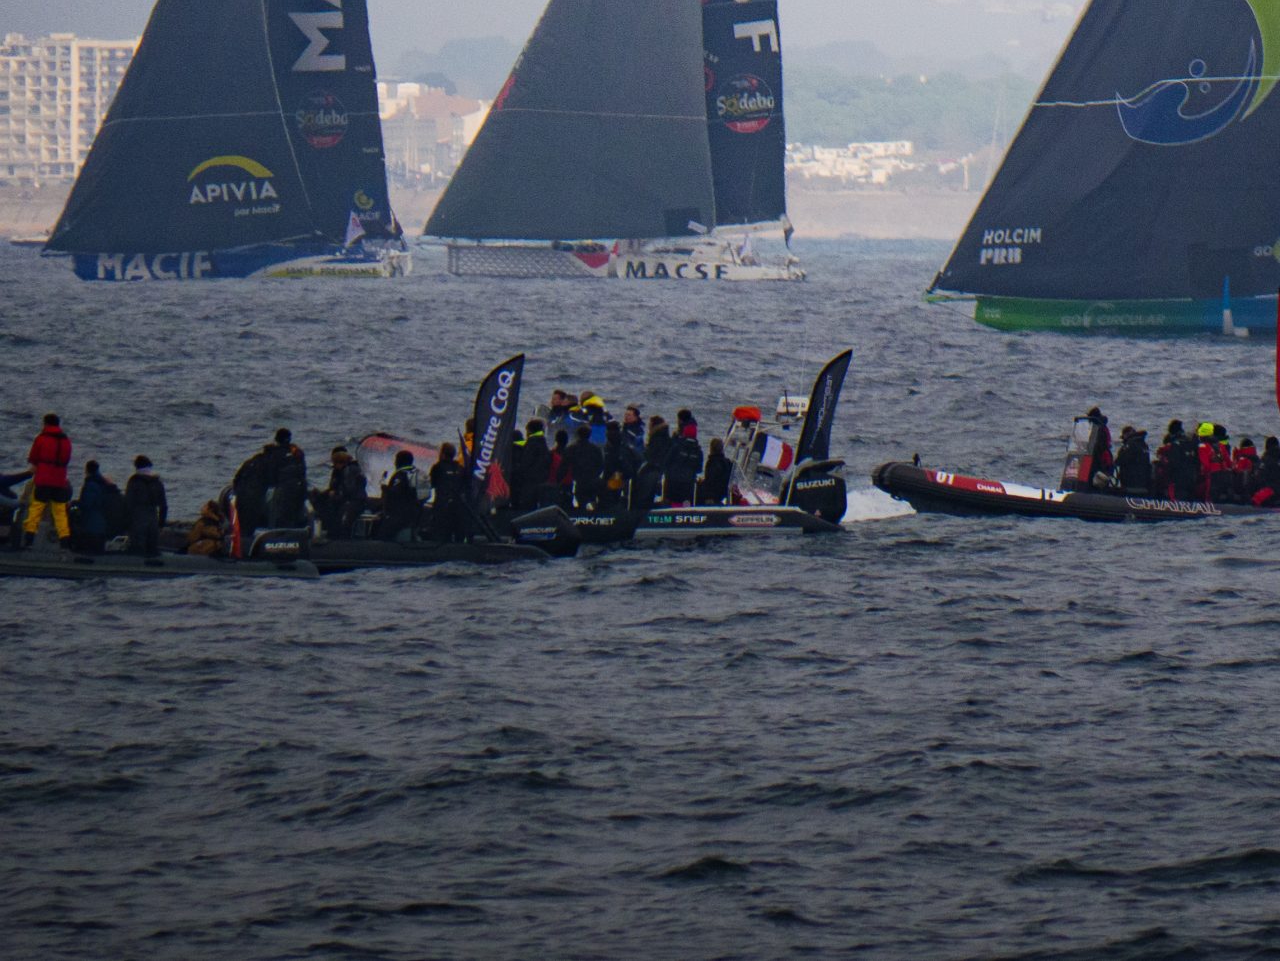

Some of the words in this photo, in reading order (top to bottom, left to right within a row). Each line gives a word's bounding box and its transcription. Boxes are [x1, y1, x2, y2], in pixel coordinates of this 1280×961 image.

[190, 180, 278, 204] APIVIA
[983, 227, 1042, 245] HOLCIM
[97, 252, 212, 280] MACIF
[625, 260, 729, 279] MACSF
[474, 416, 502, 480] Maître
[795, 478, 836, 489] SUZUKI
[936, 471, 955, 485] 01
[1126, 497, 1222, 516] CHARAL
